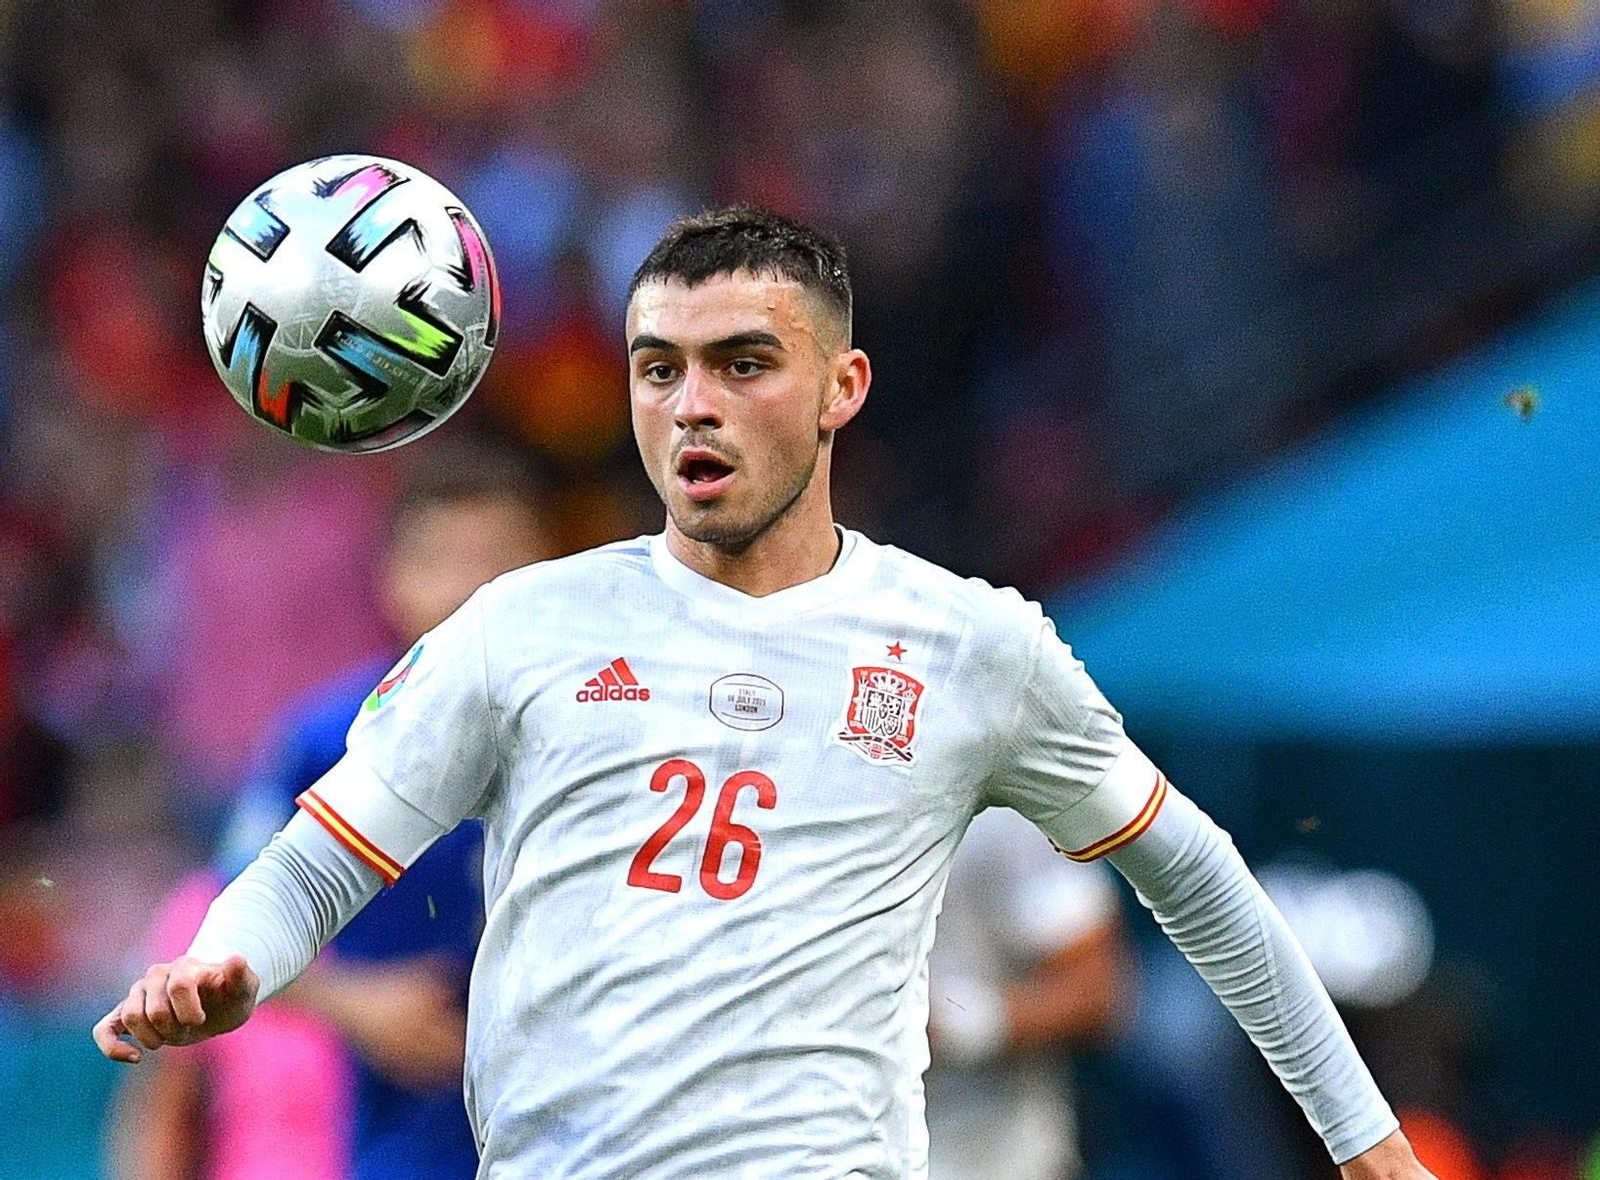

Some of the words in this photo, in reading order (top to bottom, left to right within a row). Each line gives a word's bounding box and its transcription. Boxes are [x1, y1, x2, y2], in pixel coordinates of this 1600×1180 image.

[576, 684, 650, 703] adidas
[735, 704, 758, 713] LONDON
[626, 759, 777, 900] 26
